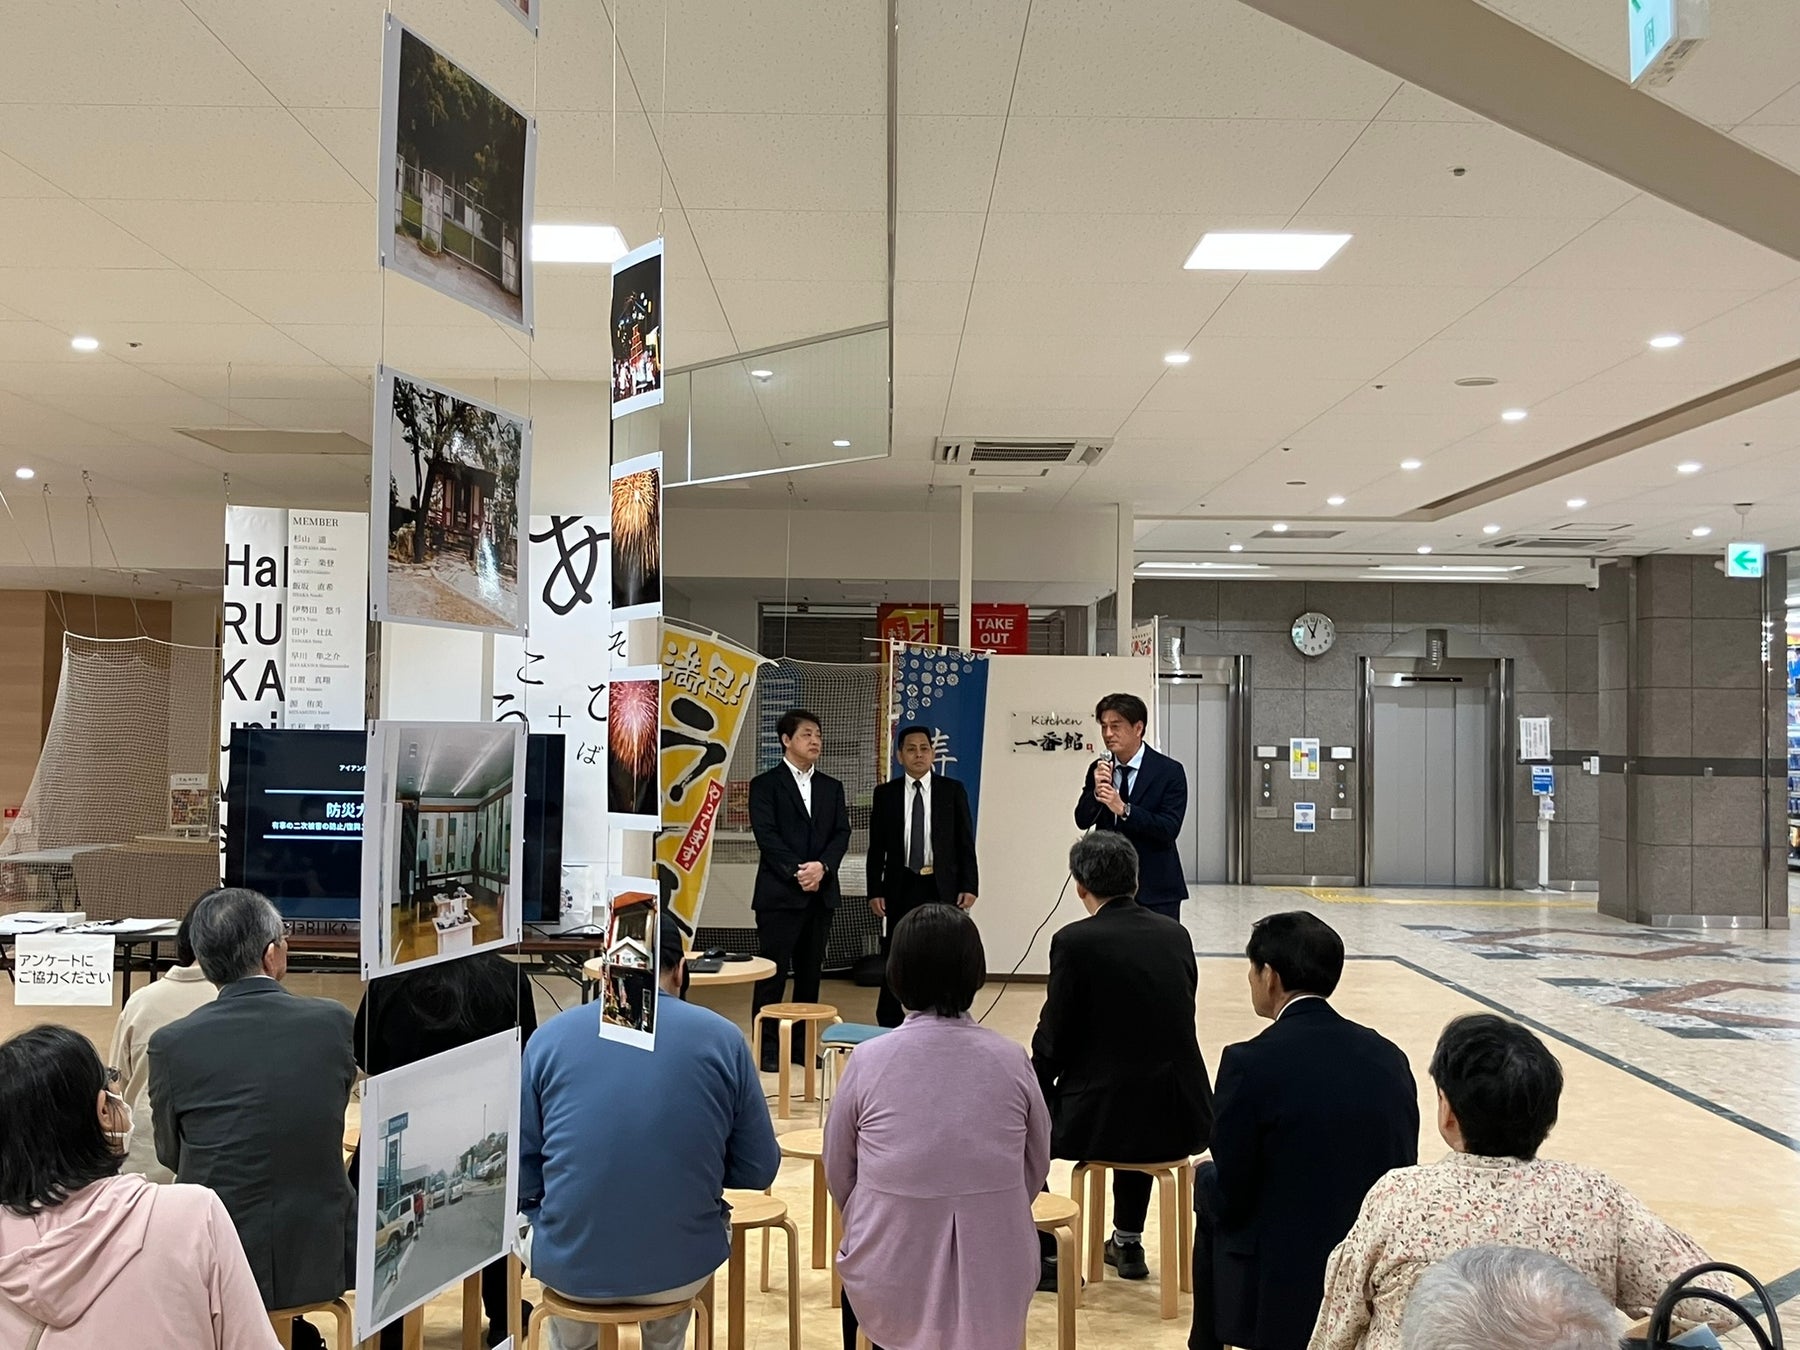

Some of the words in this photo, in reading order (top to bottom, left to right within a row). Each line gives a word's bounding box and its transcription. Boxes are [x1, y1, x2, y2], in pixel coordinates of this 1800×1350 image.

[292, 517, 339, 527] MEMBER
[976, 618, 1014, 630] TAKE
[291, 628, 309, 636] 田中
[980, 633, 1010, 644] OUT
[608, 630, 627, 658] そ
[516, 650, 546, 685] こ
[1031, 715, 1083, 726] Kitchen
[576, 741, 604, 766] ば
[682, 783, 721, 869] やってます。
[18, 953, 94, 968] アンケートに
[18, 970, 112, 985] ご協力ください
